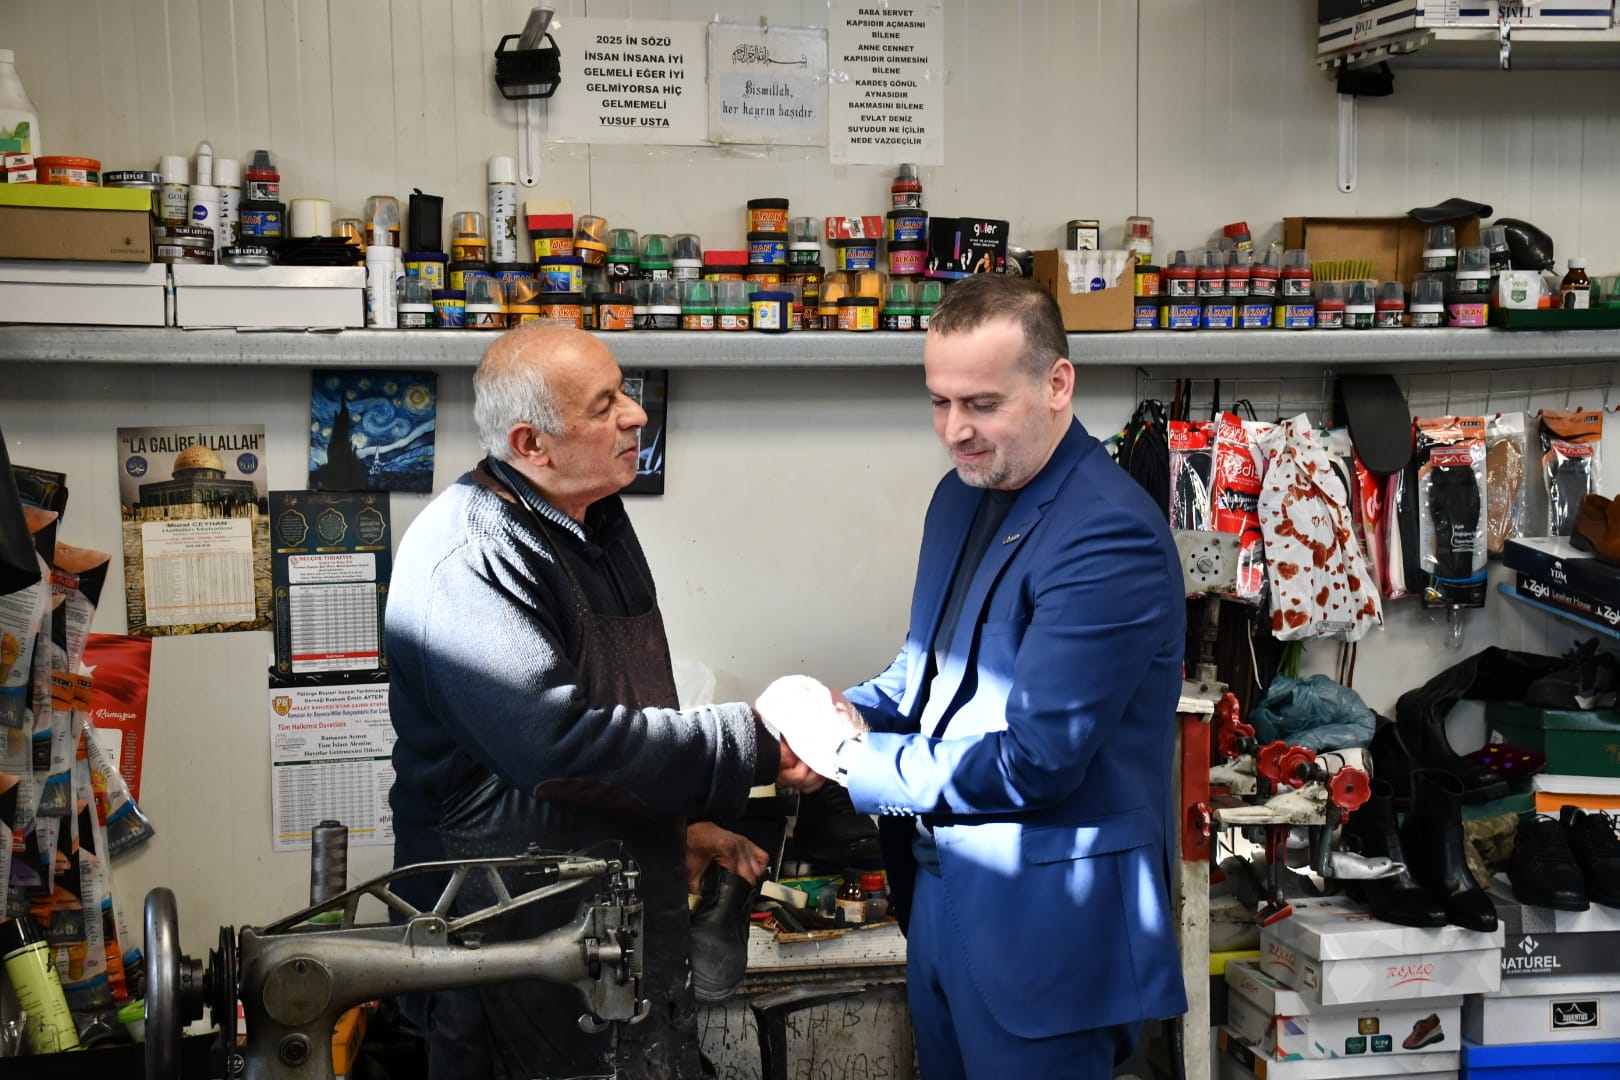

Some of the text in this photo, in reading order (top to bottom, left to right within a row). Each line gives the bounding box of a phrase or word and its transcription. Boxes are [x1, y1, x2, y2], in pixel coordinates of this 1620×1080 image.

[883, 9, 914, 17] SERVET
[886, 21, 926, 29] AÇMASINI
[872, 31, 901, 39] BİLENE
[596, 35, 671, 47] 2025 İN SÖZÜ
[584, 50, 683, 64] İNSAN İNSANA İYİ
[844, 55, 928, 64] KAPISIDIR GİRMESİNİ
[584, 67, 684, 79] GELMELİ EĞER İYİ
[872, 66, 901, 74] BİLENE
[855, 80, 918, 88] KARDEŞ GÖNÜL
[586, 83, 682, 96] GELMİYORSA HİÇ
[602, 99, 667, 109] GELMEMELİ
[896, 102, 924, 110] BİLENE
[600, 116, 670, 127] YUSUF USTA
[902, 126, 925, 134] İÇİLİR
[874, 138, 922, 146] VAZGEÇİLİR
[847, 250, 875, 258] ALKAN
[95, 710, 137, 720] Ramazan
[1501, 955, 1561, 969] NATUREL
[1562, 1013, 1589, 1022] JUVENTUS
